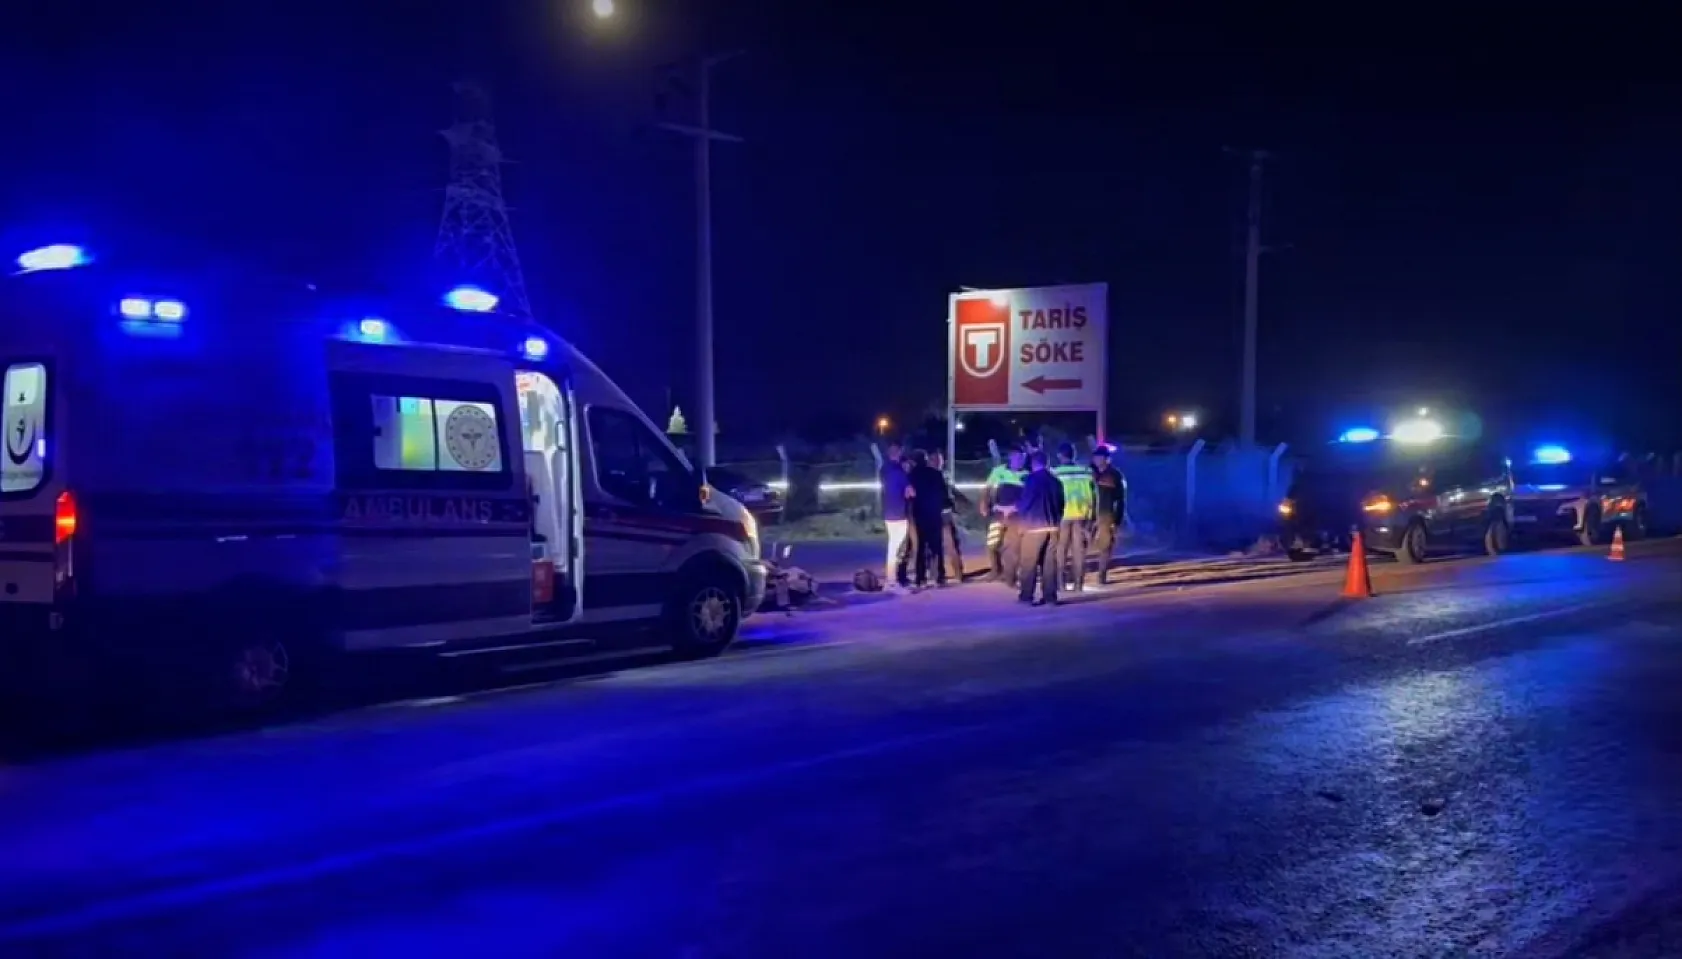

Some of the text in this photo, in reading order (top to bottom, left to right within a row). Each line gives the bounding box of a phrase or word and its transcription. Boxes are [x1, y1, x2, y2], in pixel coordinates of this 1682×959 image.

[968, 331, 997, 368] T
[1020, 338, 1084, 363] SÖKE
[343, 496, 493, 523] AMBULANS
